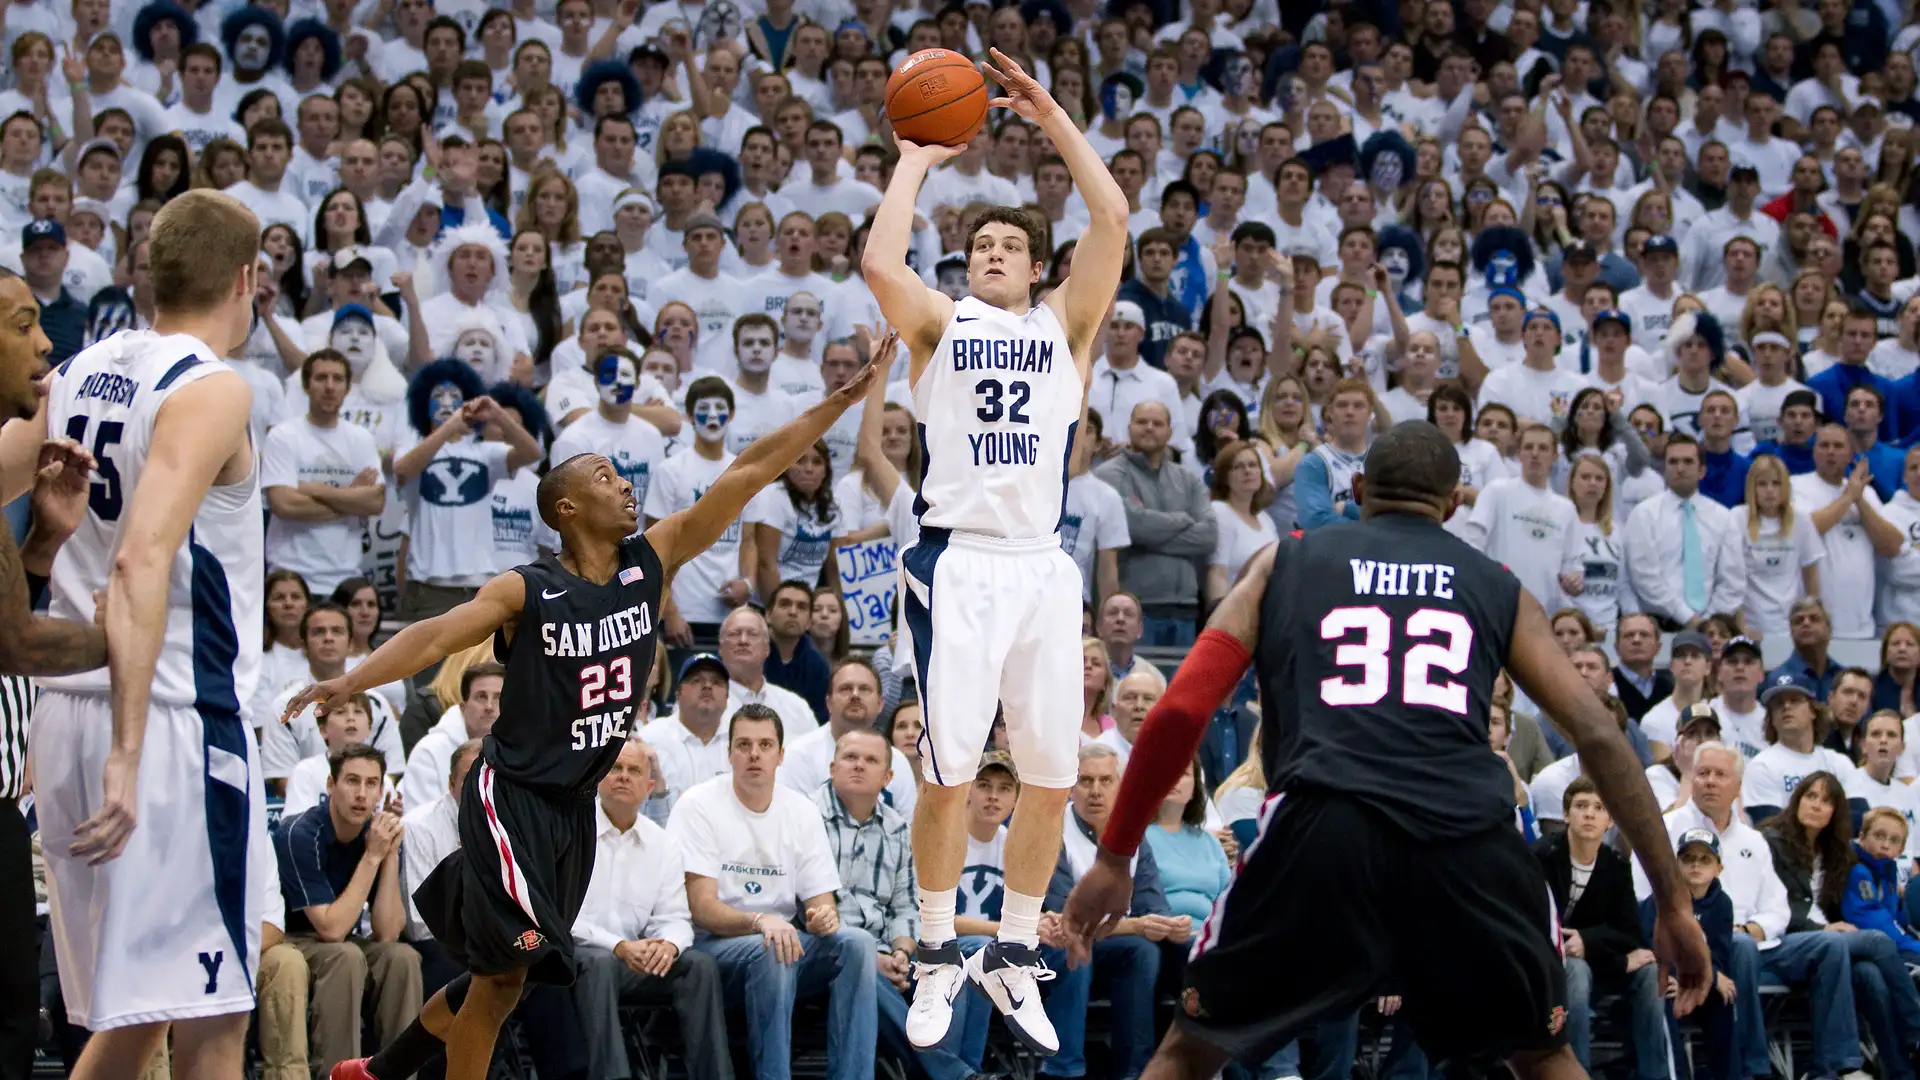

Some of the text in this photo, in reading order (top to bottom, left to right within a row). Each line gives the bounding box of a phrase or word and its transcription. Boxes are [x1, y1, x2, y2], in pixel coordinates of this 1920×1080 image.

[952, 338, 1054, 373] BRIGHAM
[74, 371, 139, 409] ANDERSN
[975, 378, 1031, 424] 32
[967, 431, 1040, 466] YOUNG
[1349, 558, 1455, 600] WHITE
[541, 601, 652, 657] SAN DIEGO
[843, 584, 898, 630] Jac
[1319, 604, 1474, 715] 32
[579, 655, 633, 710] 23
[198, 950, 224, 995] Y
